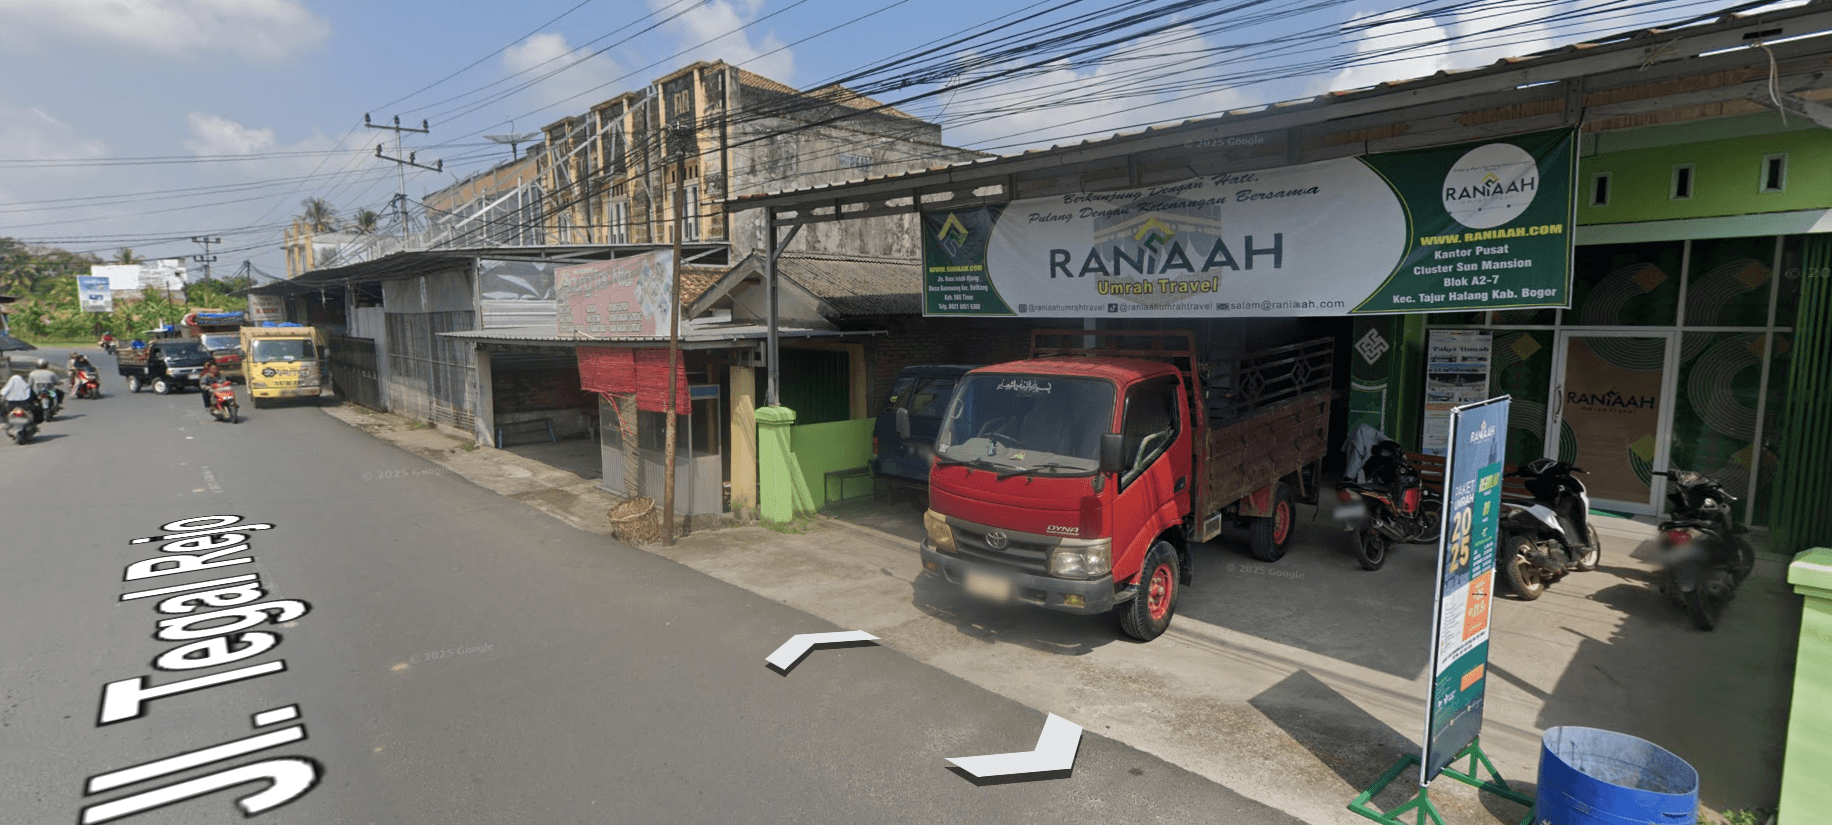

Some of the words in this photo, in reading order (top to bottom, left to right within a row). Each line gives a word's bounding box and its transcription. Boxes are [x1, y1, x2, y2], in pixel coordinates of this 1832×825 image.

[1063, 189, 1141, 205] Berkunjung
[1147, 180, 1204, 197] Dengan
[1211, 173, 1260, 187] Hati,
[1445, 177, 1535, 201] RANIAAH
[1028, 211, 1073, 225] Pulang
[1079, 206, 1129, 220] Dengan
[1136, 194, 1227, 214] Ketenangan
[1420, 234, 1461, 246] WWW.
[1464, 224, 1563, 243] RANIAAH.COM
[1050, 232, 1283, 279] RANIAAH
[1434, 248, 1472, 260] Kantor
[1475, 244, 1509, 256] Pusat
[1413, 264, 1453, 275] Cluster
[1456, 262, 1478, 272] Sun
[1481, 258, 1532, 271] Mansion
[1097, 279, 1153, 295] Umrah
[1157, 276, 1218, 294] Travel
[1443, 276, 1468, 287] Blok
[1471, 275, 1499, 286] A2-7
[1393, 295, 1416, 304] Kec.
[1418, 293, 1446, 304] Tajur
[1449, 291, 1488, 302] Halang
[1492, 289, 1517, 299] Kab.
[1521, 288, 1556, 299] Bogor
[1567, 391, 1655, 410] RANIAAH
[1454, 479, 1476, 498] PAKET
[1046, 524, 1080, 533] DYNA
[1452, 507, 1472, 543] 20
[1450, 535, 1471, 573] 25
